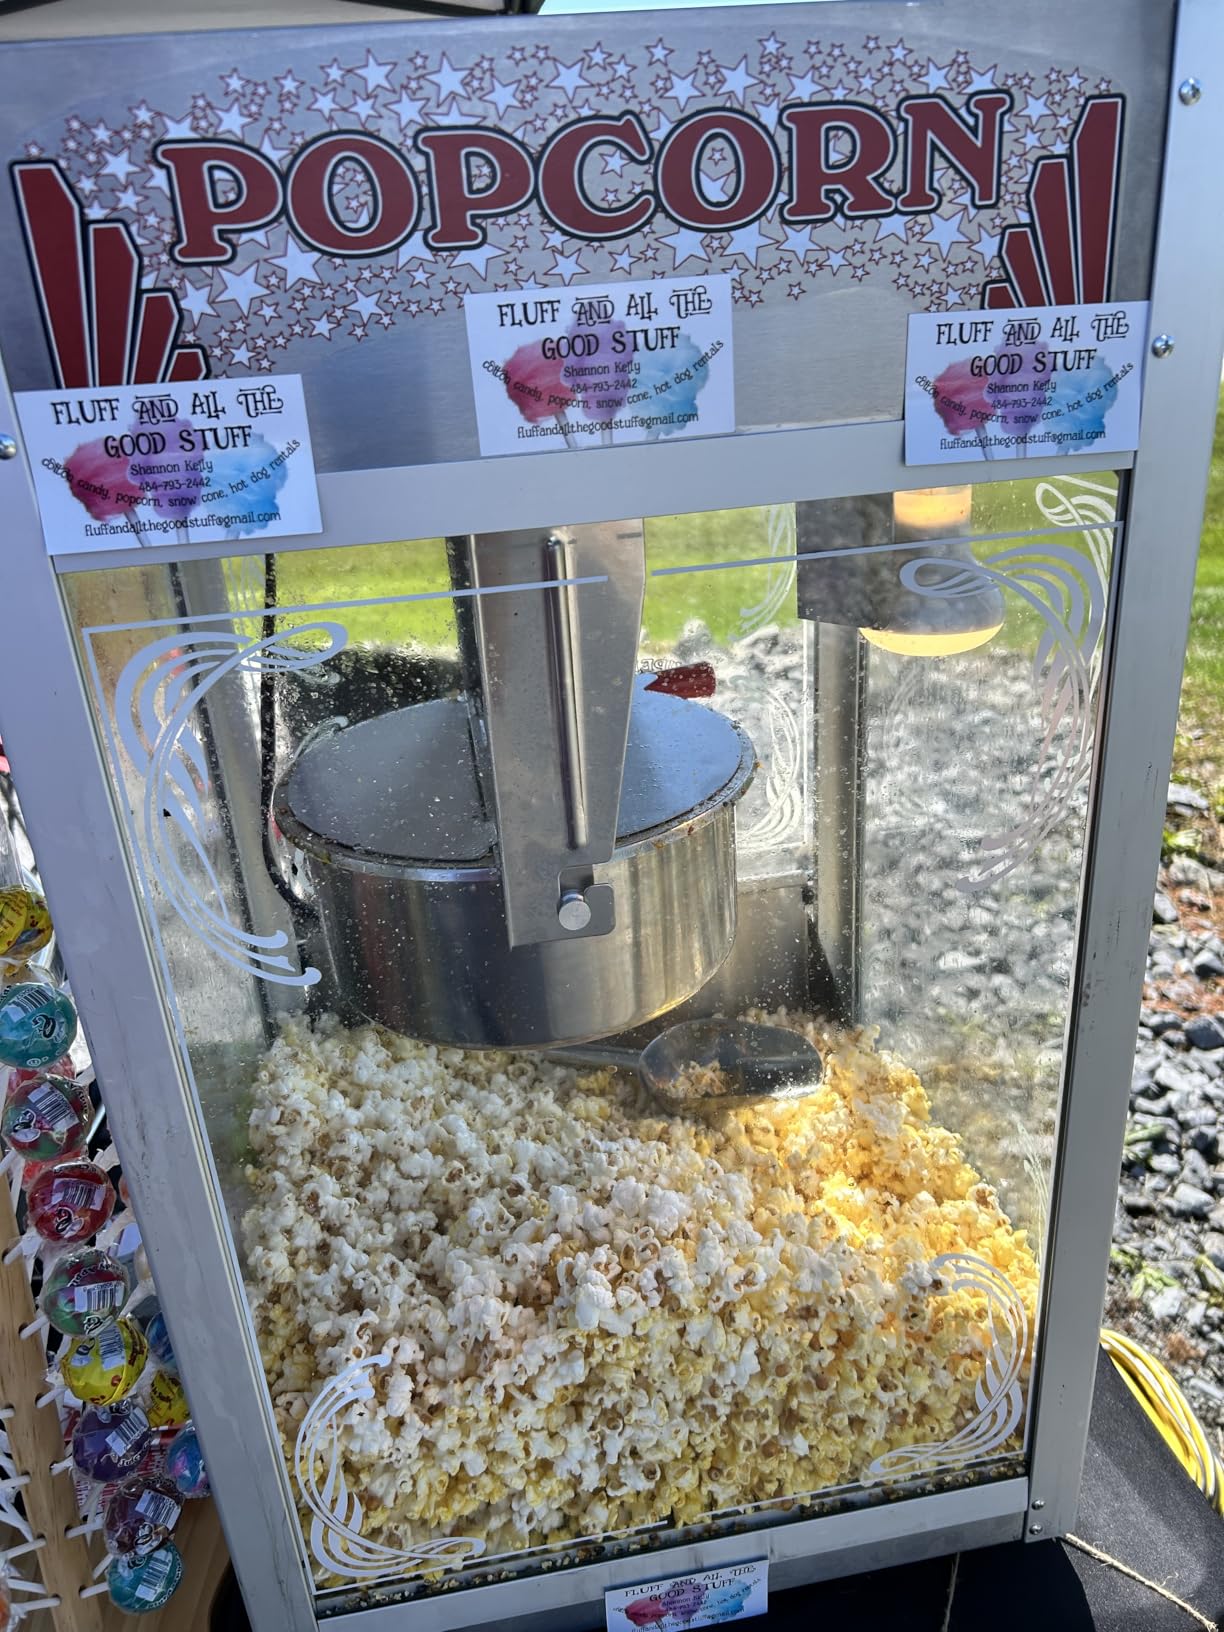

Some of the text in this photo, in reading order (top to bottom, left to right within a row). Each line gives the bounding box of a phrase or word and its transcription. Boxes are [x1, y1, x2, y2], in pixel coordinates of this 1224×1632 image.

[153, 87, 1014, 267] POPCORN
[497, 285, 712, 327] FLUFF AND ALL THE
[936, 311, 1130, 346] FLUFF AND ALL THE
[541, 327, 680, 360] GOOD STUFF
[548, 394, 591, 409] popcorn,
[596, 398, 623, 409] snow
[627, 392, 652, 405] cone,
[653, 380, 672, 396] hot
[674, 369, 693, 385] dog
[692, 339, 725, 372] rentals
[563, 361, 641, 378] Shannon Kelly
[970, 349, 1097, 377] GOOD STUFF
[570, 379, 638, 394] 484-793-2442
[970, 410, 1009, 425] popcorn,
[1013, 414, 1037, 424] snow
[1041, 409, 1065, 421] cone,
[1066, 399, 1083, 413] hot
[1085, 388, 1104, 403] dog
[1103, 362, 1134, 392] rentals
[987, 380, 1057, 395] Shannon Kelly
[51, 384, 284, 426] FLUFF AND ALL THE
[991, 397, 1053, 409] 484-793-2442
[517, 412, 699, 439] fluffandallthegoodstuff@gmail.com
[104, 425, 252, 459] GOOD STUFF
[940, 429, 1106, 450] fluffandallthegoodstuff@gmail.com
[115, 491, 163, 508] popcorn,
[168, 496, 197, 507] snow
[201, 490, 229, 504] cone,
[229, 478, 249, 494] hot
[251, 468, 271, 485] dog
[269, 439, 301, 474] rentals
[130, 459, 214, 476] Shannon Kelly
[139, 477, 212, 492] 484-793-2442
[85, 511, 282, 537] fluffandallthegoodstuff@gmail.com
[625, 1583, 664, 1598] FLUFF
[669, 1577, 697, 1589] AND
[649, 1588, 685, 1602] GOOD
[692, 1578, 736, 1594] STUFF
